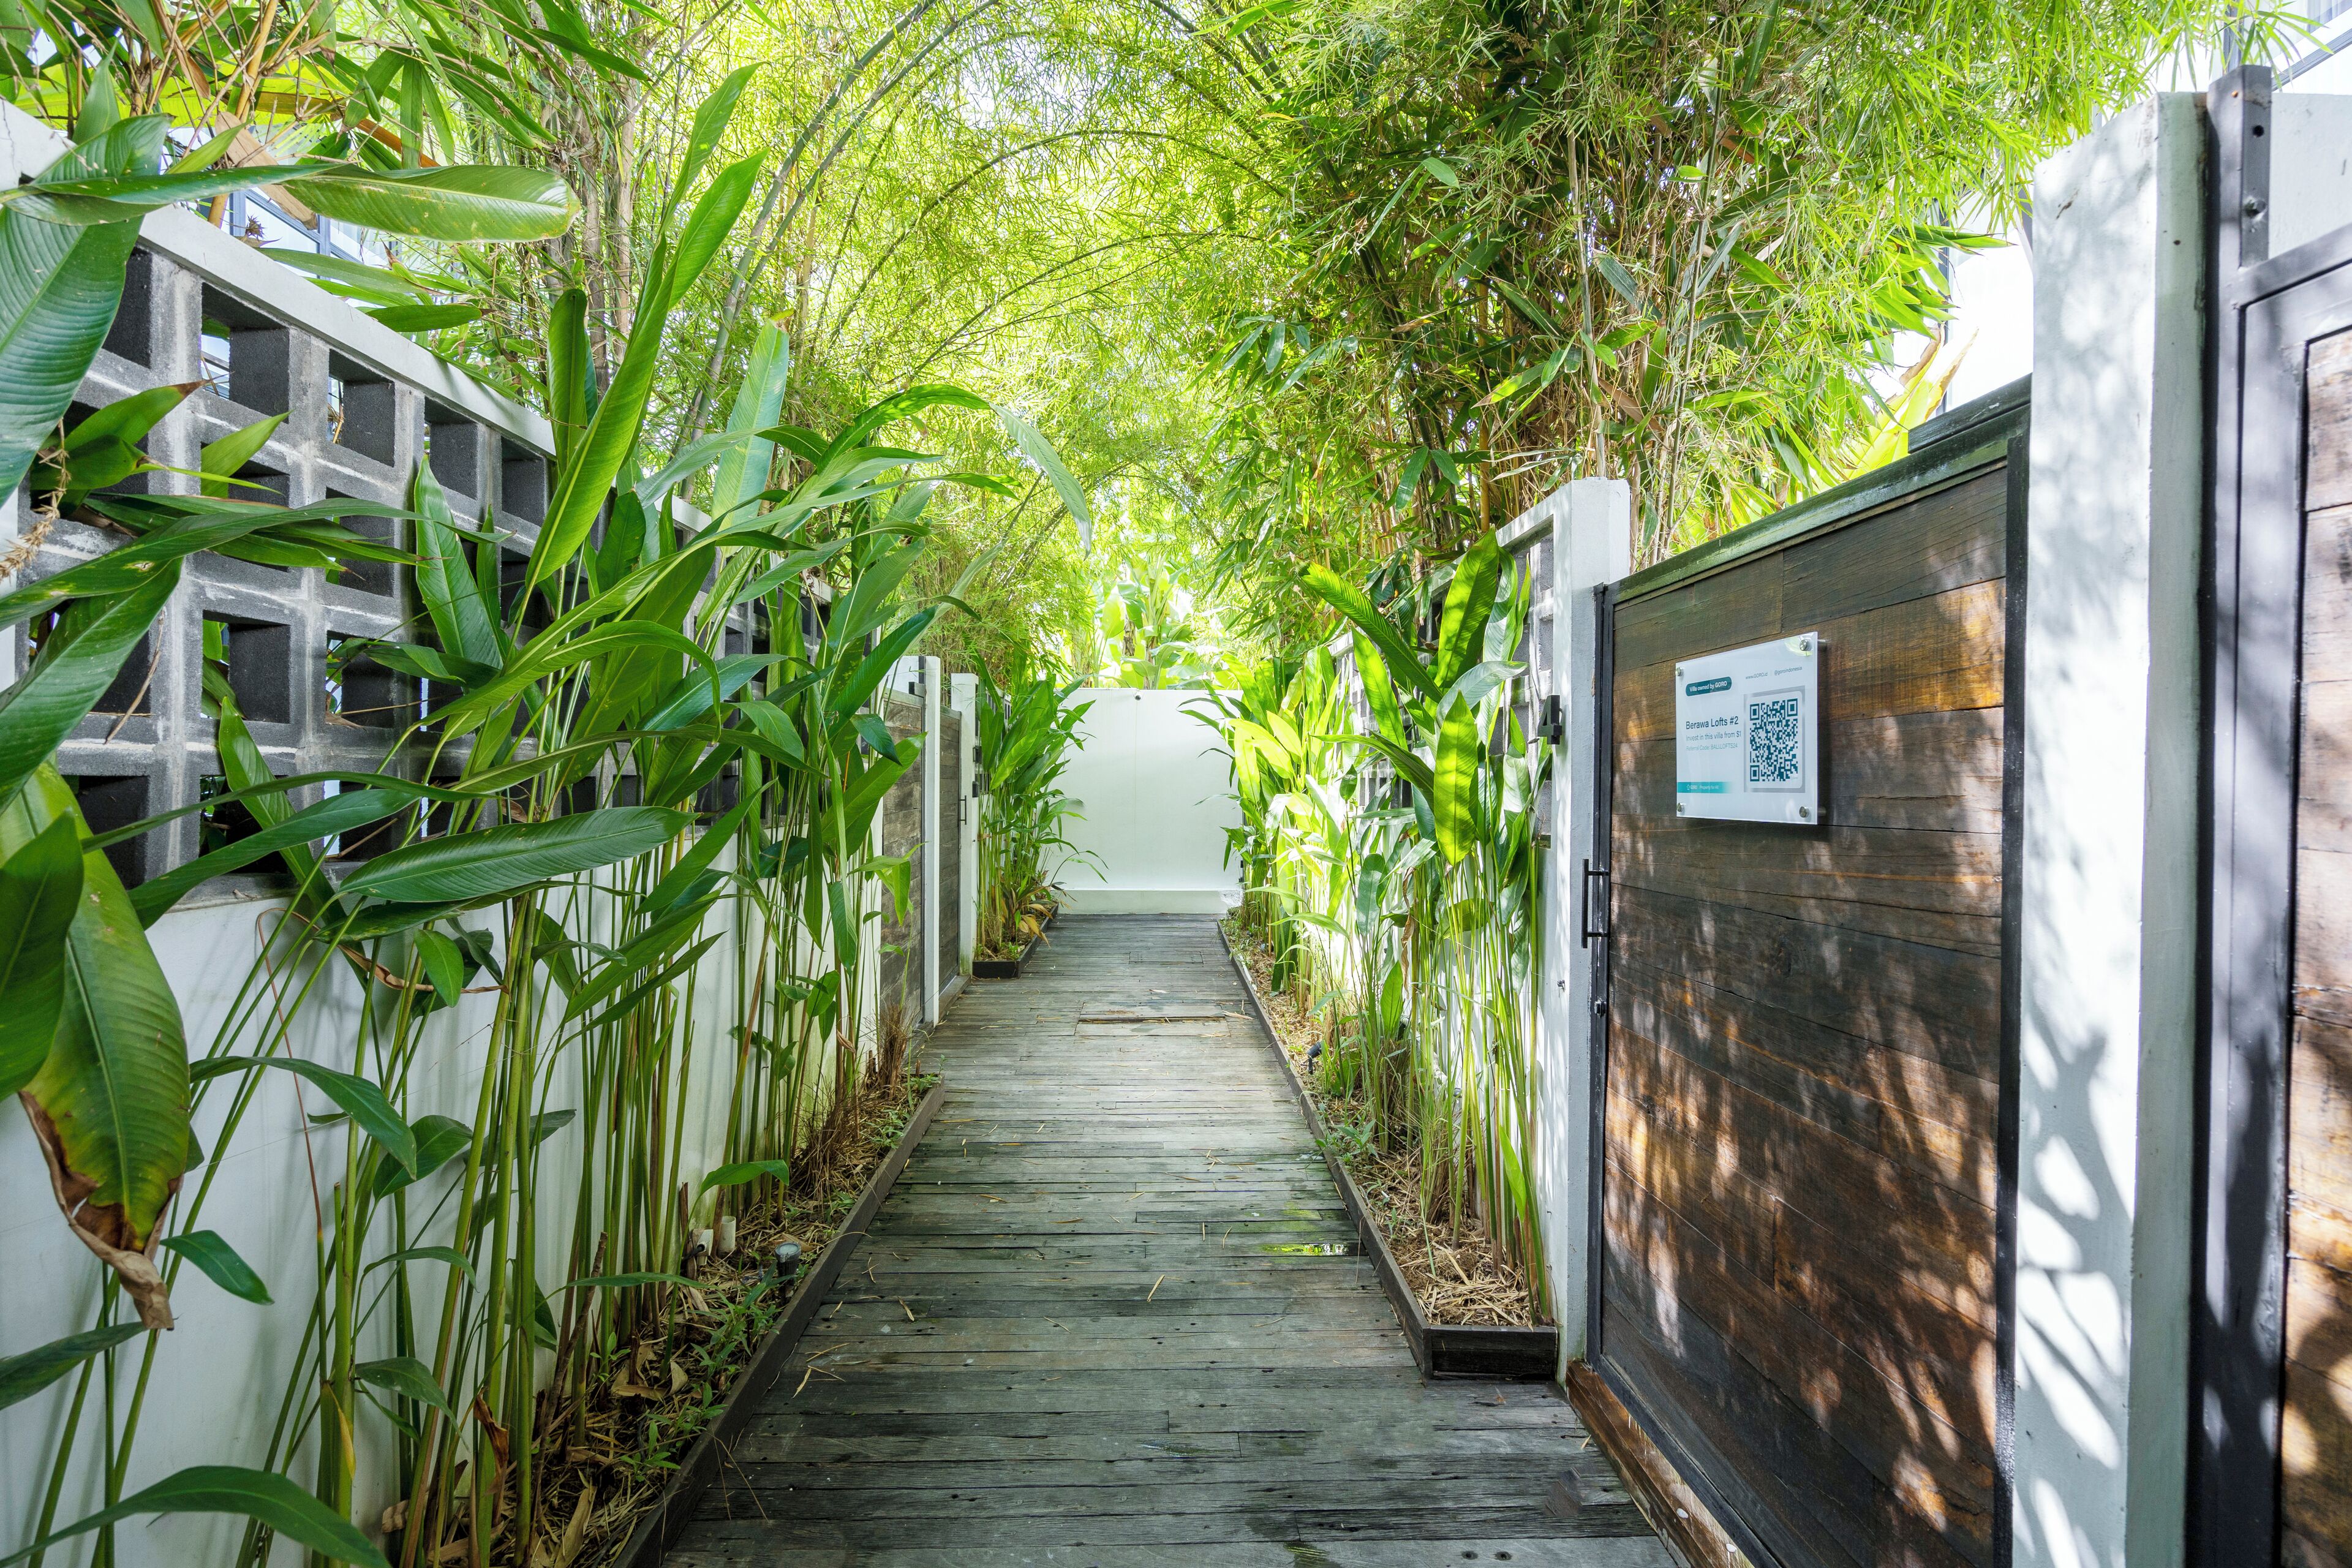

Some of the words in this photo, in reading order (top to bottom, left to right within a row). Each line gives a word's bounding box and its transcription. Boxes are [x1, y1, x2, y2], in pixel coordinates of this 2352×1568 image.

[1537, 695, 1562, 745] 4
[1686, 720, 1709, 729] Berawa
[1711, 717, 1728, 728] Lofts
[1729, 715, 1739, 725] #2
